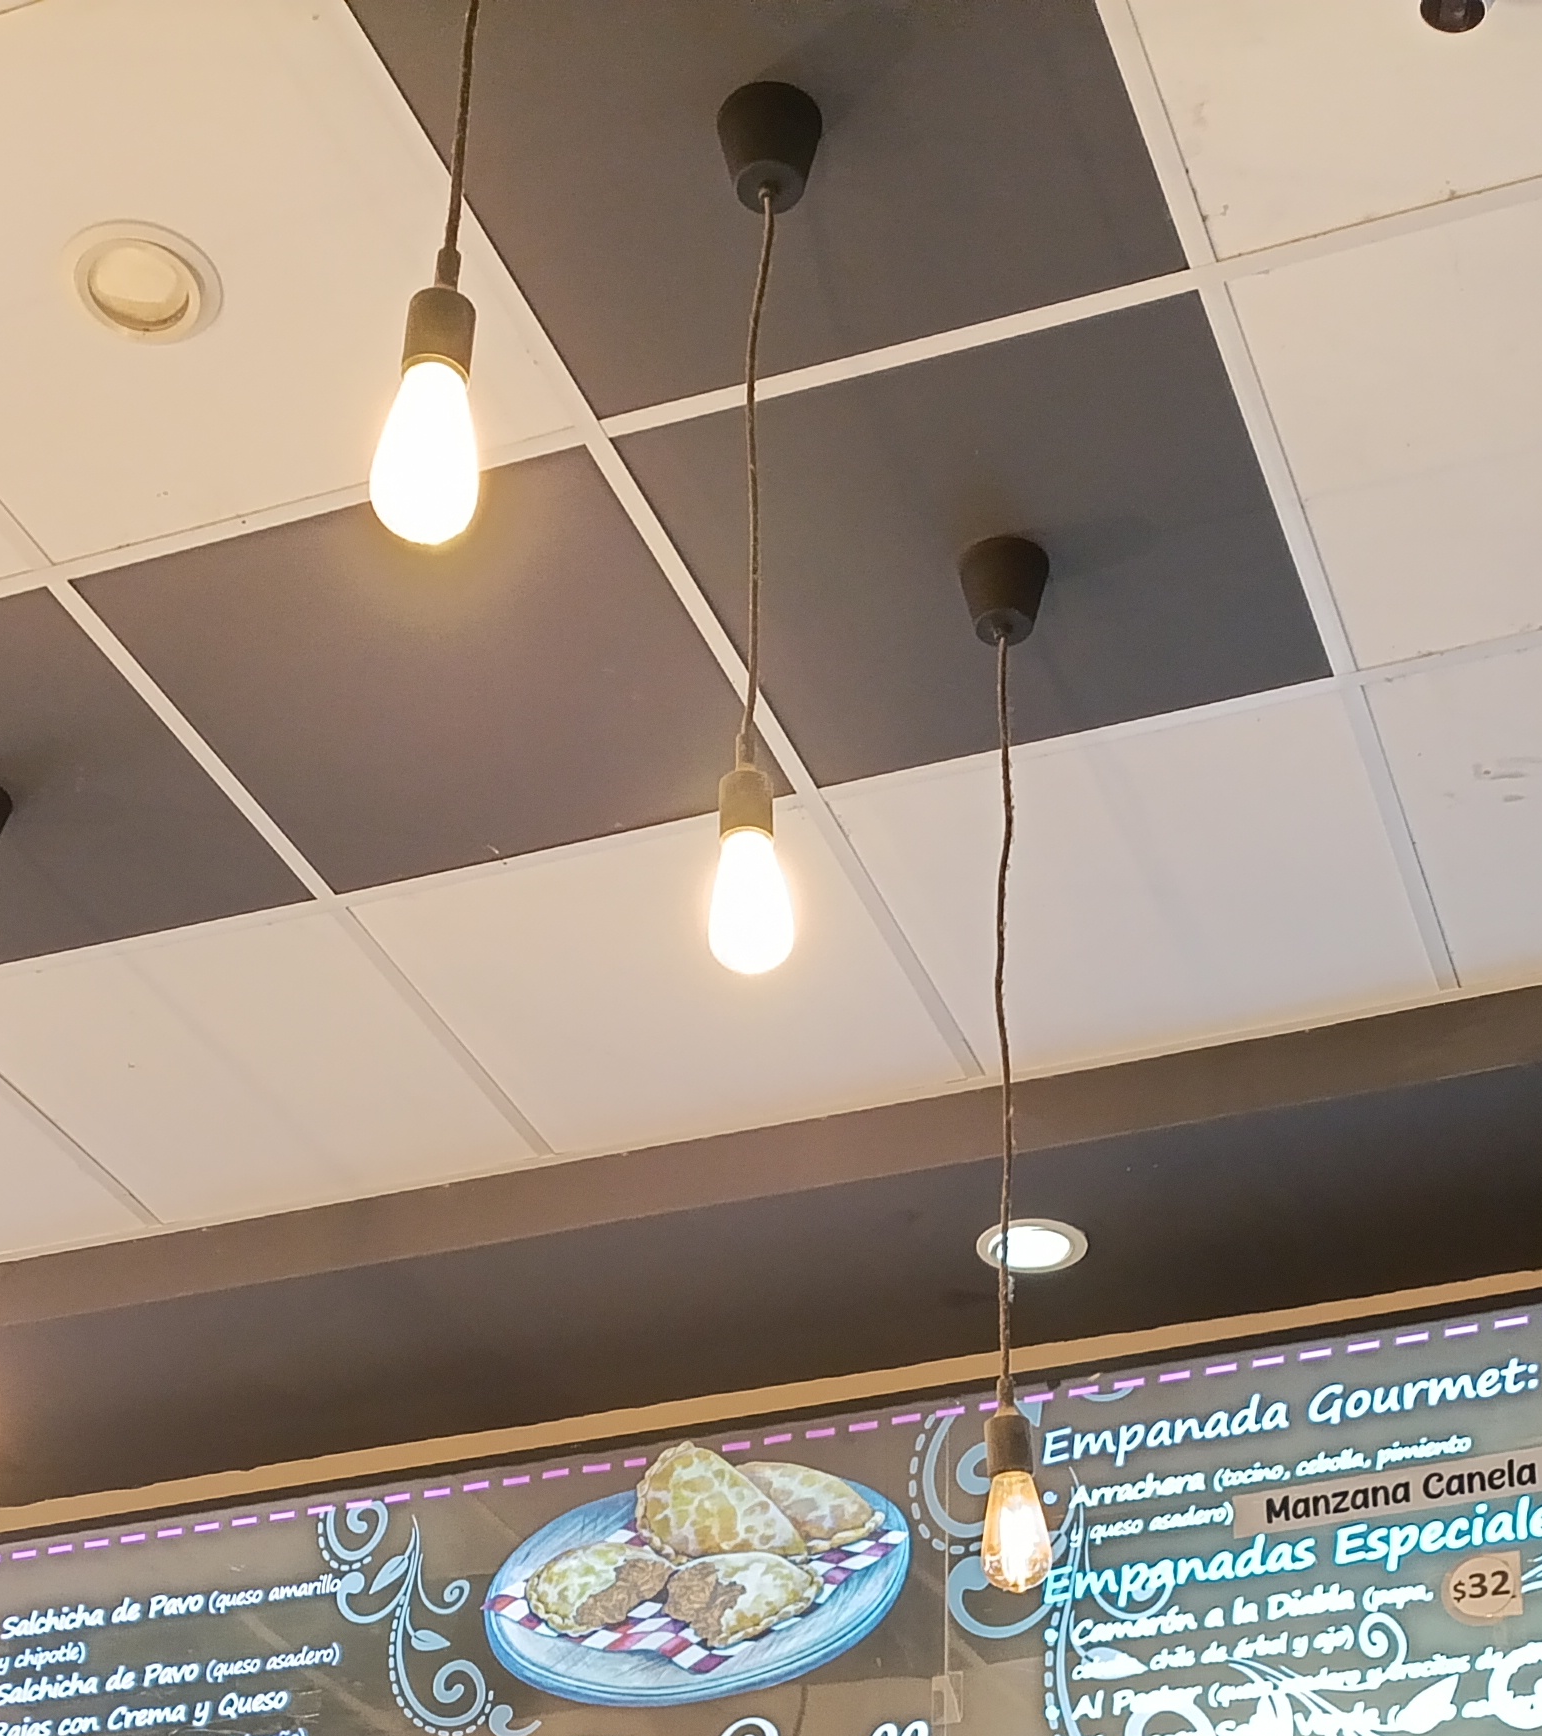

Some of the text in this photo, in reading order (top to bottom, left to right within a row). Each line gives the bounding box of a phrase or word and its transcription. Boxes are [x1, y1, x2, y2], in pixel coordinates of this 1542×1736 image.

[1041, 1397, 1290, 1469] Empanada
[1307, 1359, 1540, 1427] Gourmet:
[1264, 1457, 1538, 1525] Manzana Canela
[1041, 1532, 1317, 1608] Empanadas
[1452, 1570, 1512, 1601] $32
[57, 1714, 99, 1736] con
[107, 1705, 185, 1730] Crema
[193, 1705, 210, 1725] y
[218, 1691, 289, 1720] Queso
